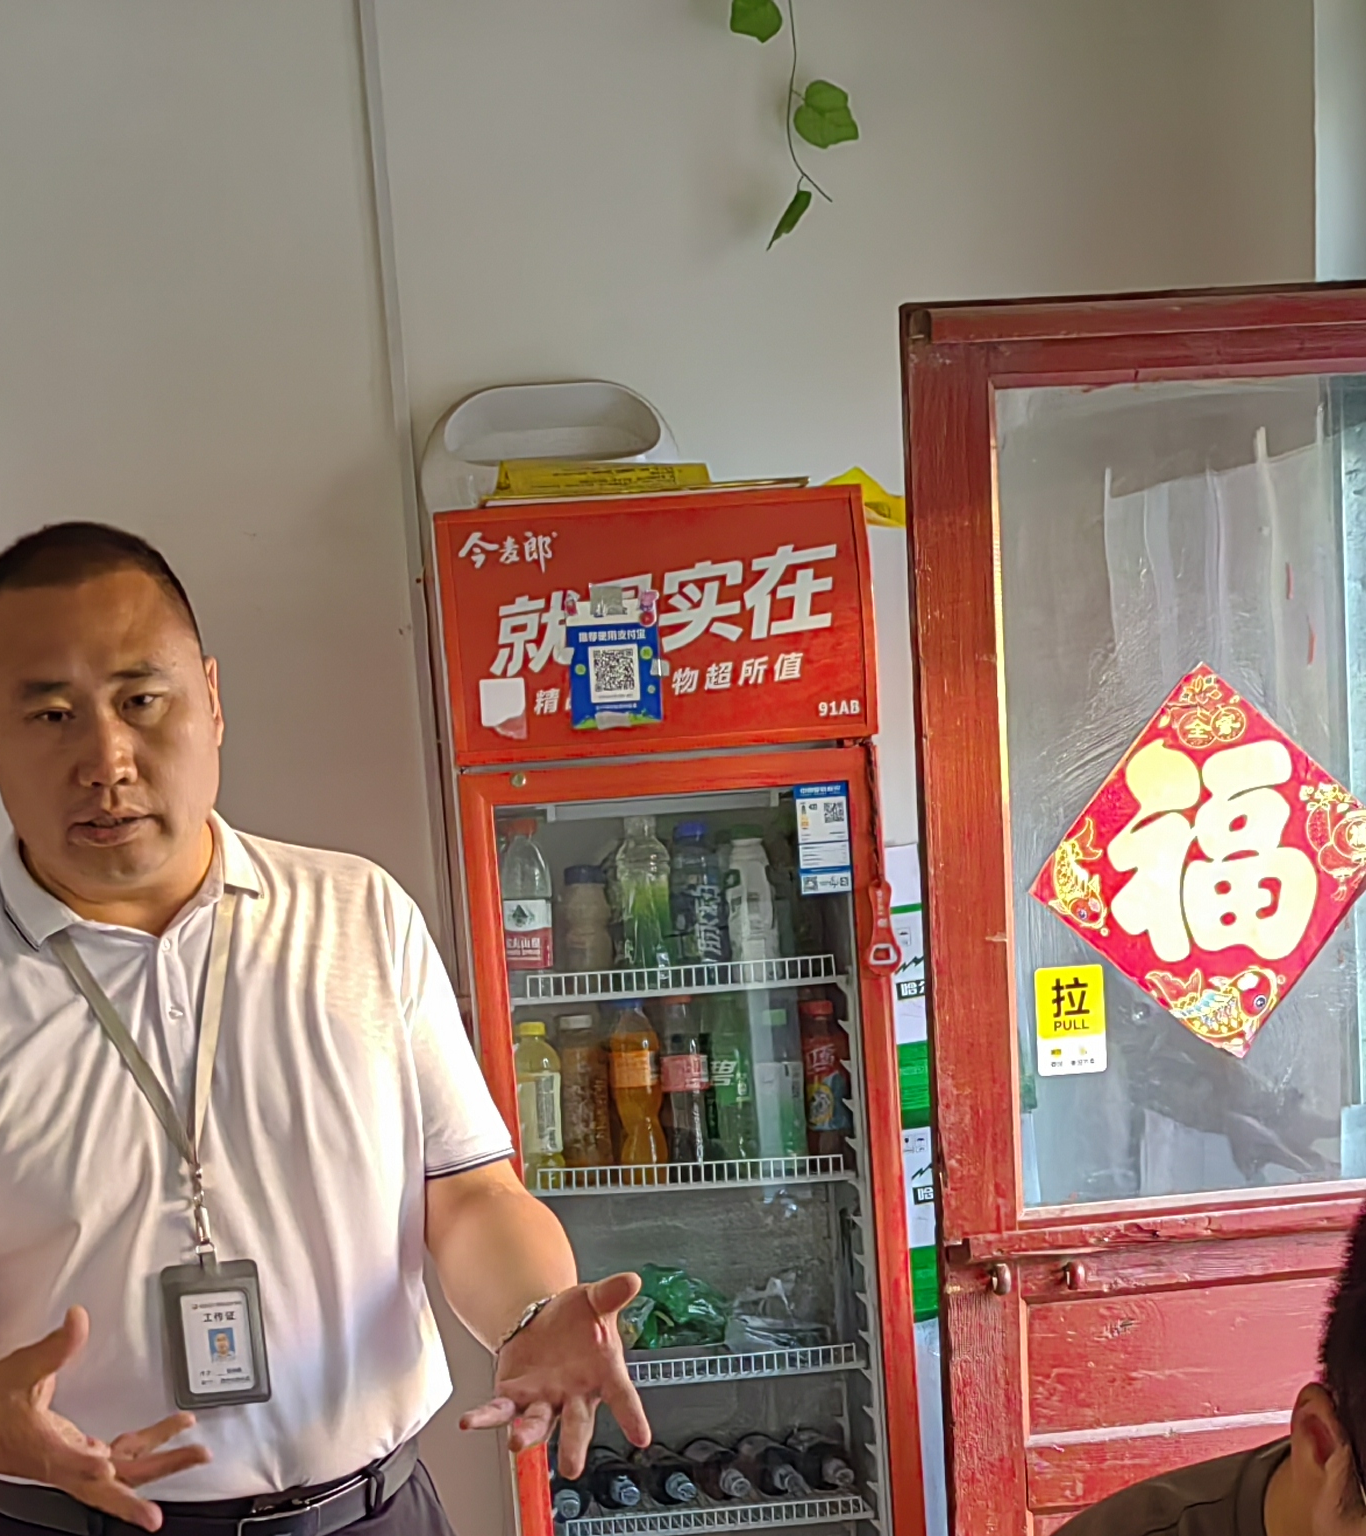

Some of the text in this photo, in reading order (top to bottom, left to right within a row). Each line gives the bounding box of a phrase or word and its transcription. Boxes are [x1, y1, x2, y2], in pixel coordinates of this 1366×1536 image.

[458, 531, 554, 574] 今麦郎
[490, 543, 837, 678] 就实在
[671, 653, 804, 696] 物超所值
[818, 700, 861, 717] 91AB
[1107, 738, 1319, 963] 福
[1051, 977, 1090, 1018] 拉
[1053, 1019, 1090, 1032] PULL
[202, 1310, 237, 1323] 工作证
